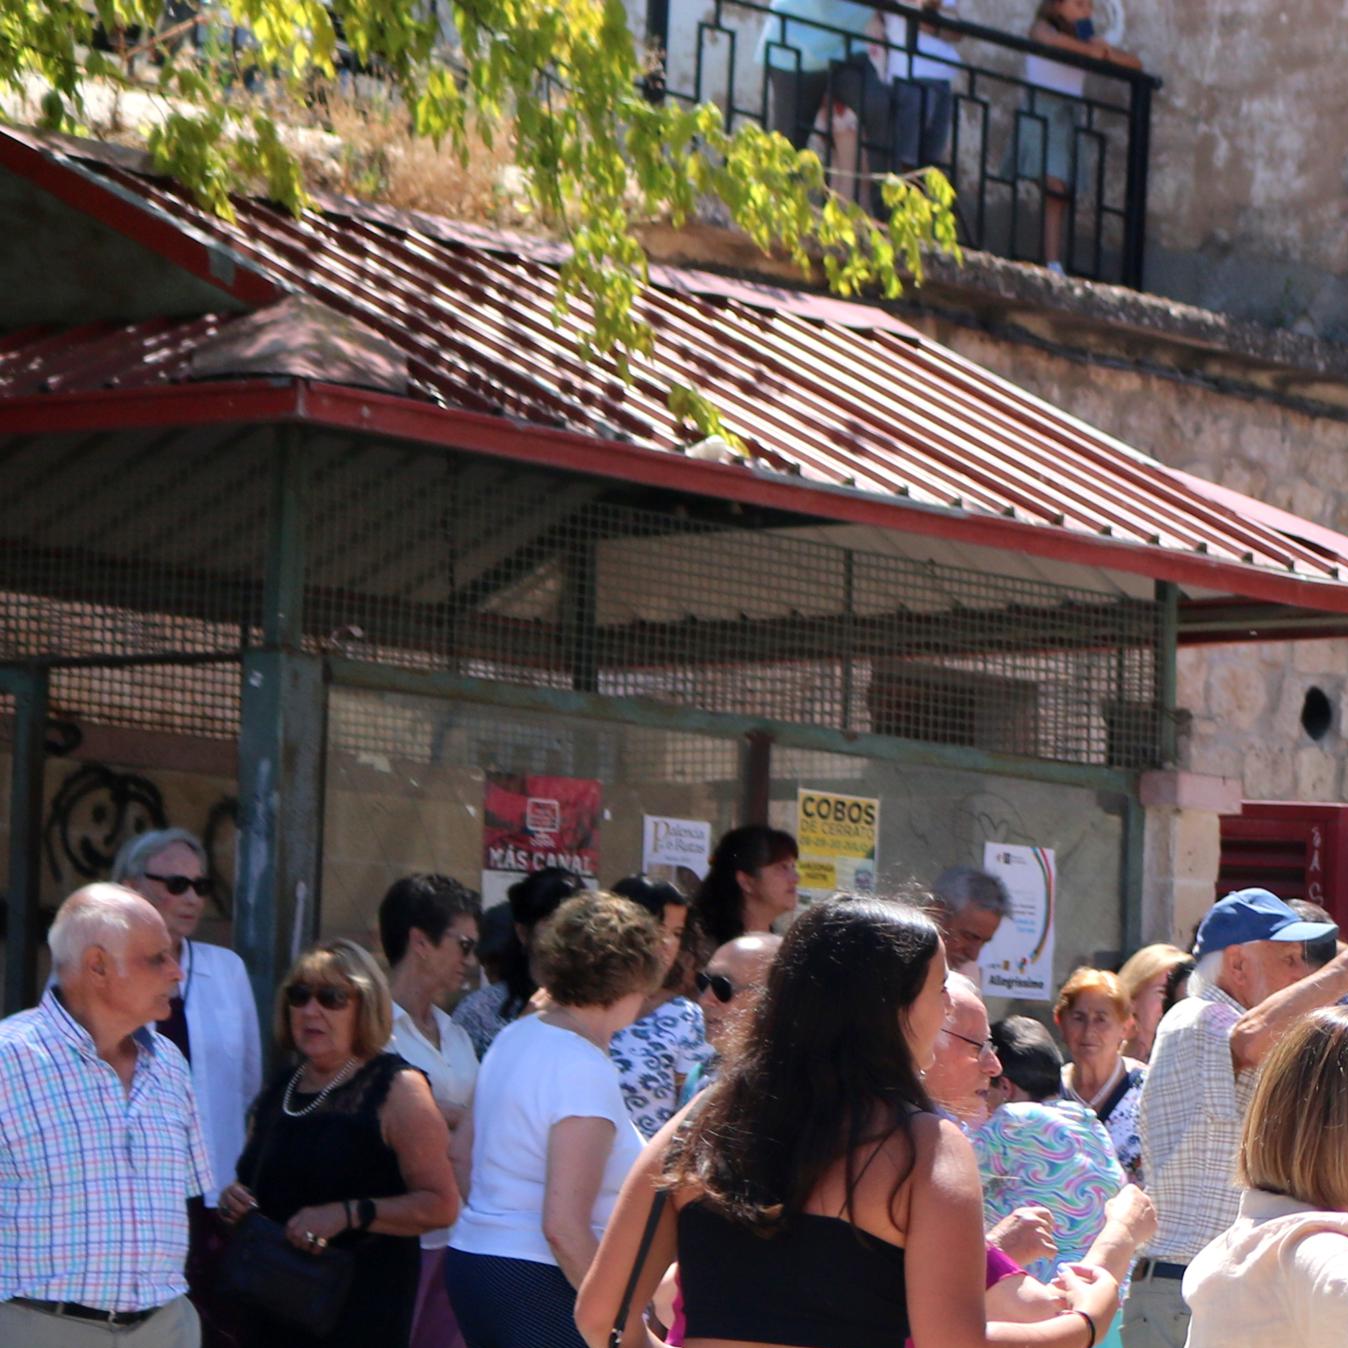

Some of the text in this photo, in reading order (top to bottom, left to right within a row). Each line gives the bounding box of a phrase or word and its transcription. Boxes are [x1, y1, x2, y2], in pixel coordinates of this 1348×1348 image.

[802, 796, 876, 825] COBOS
[489, 845, 594, 877] MÁS CANAL
